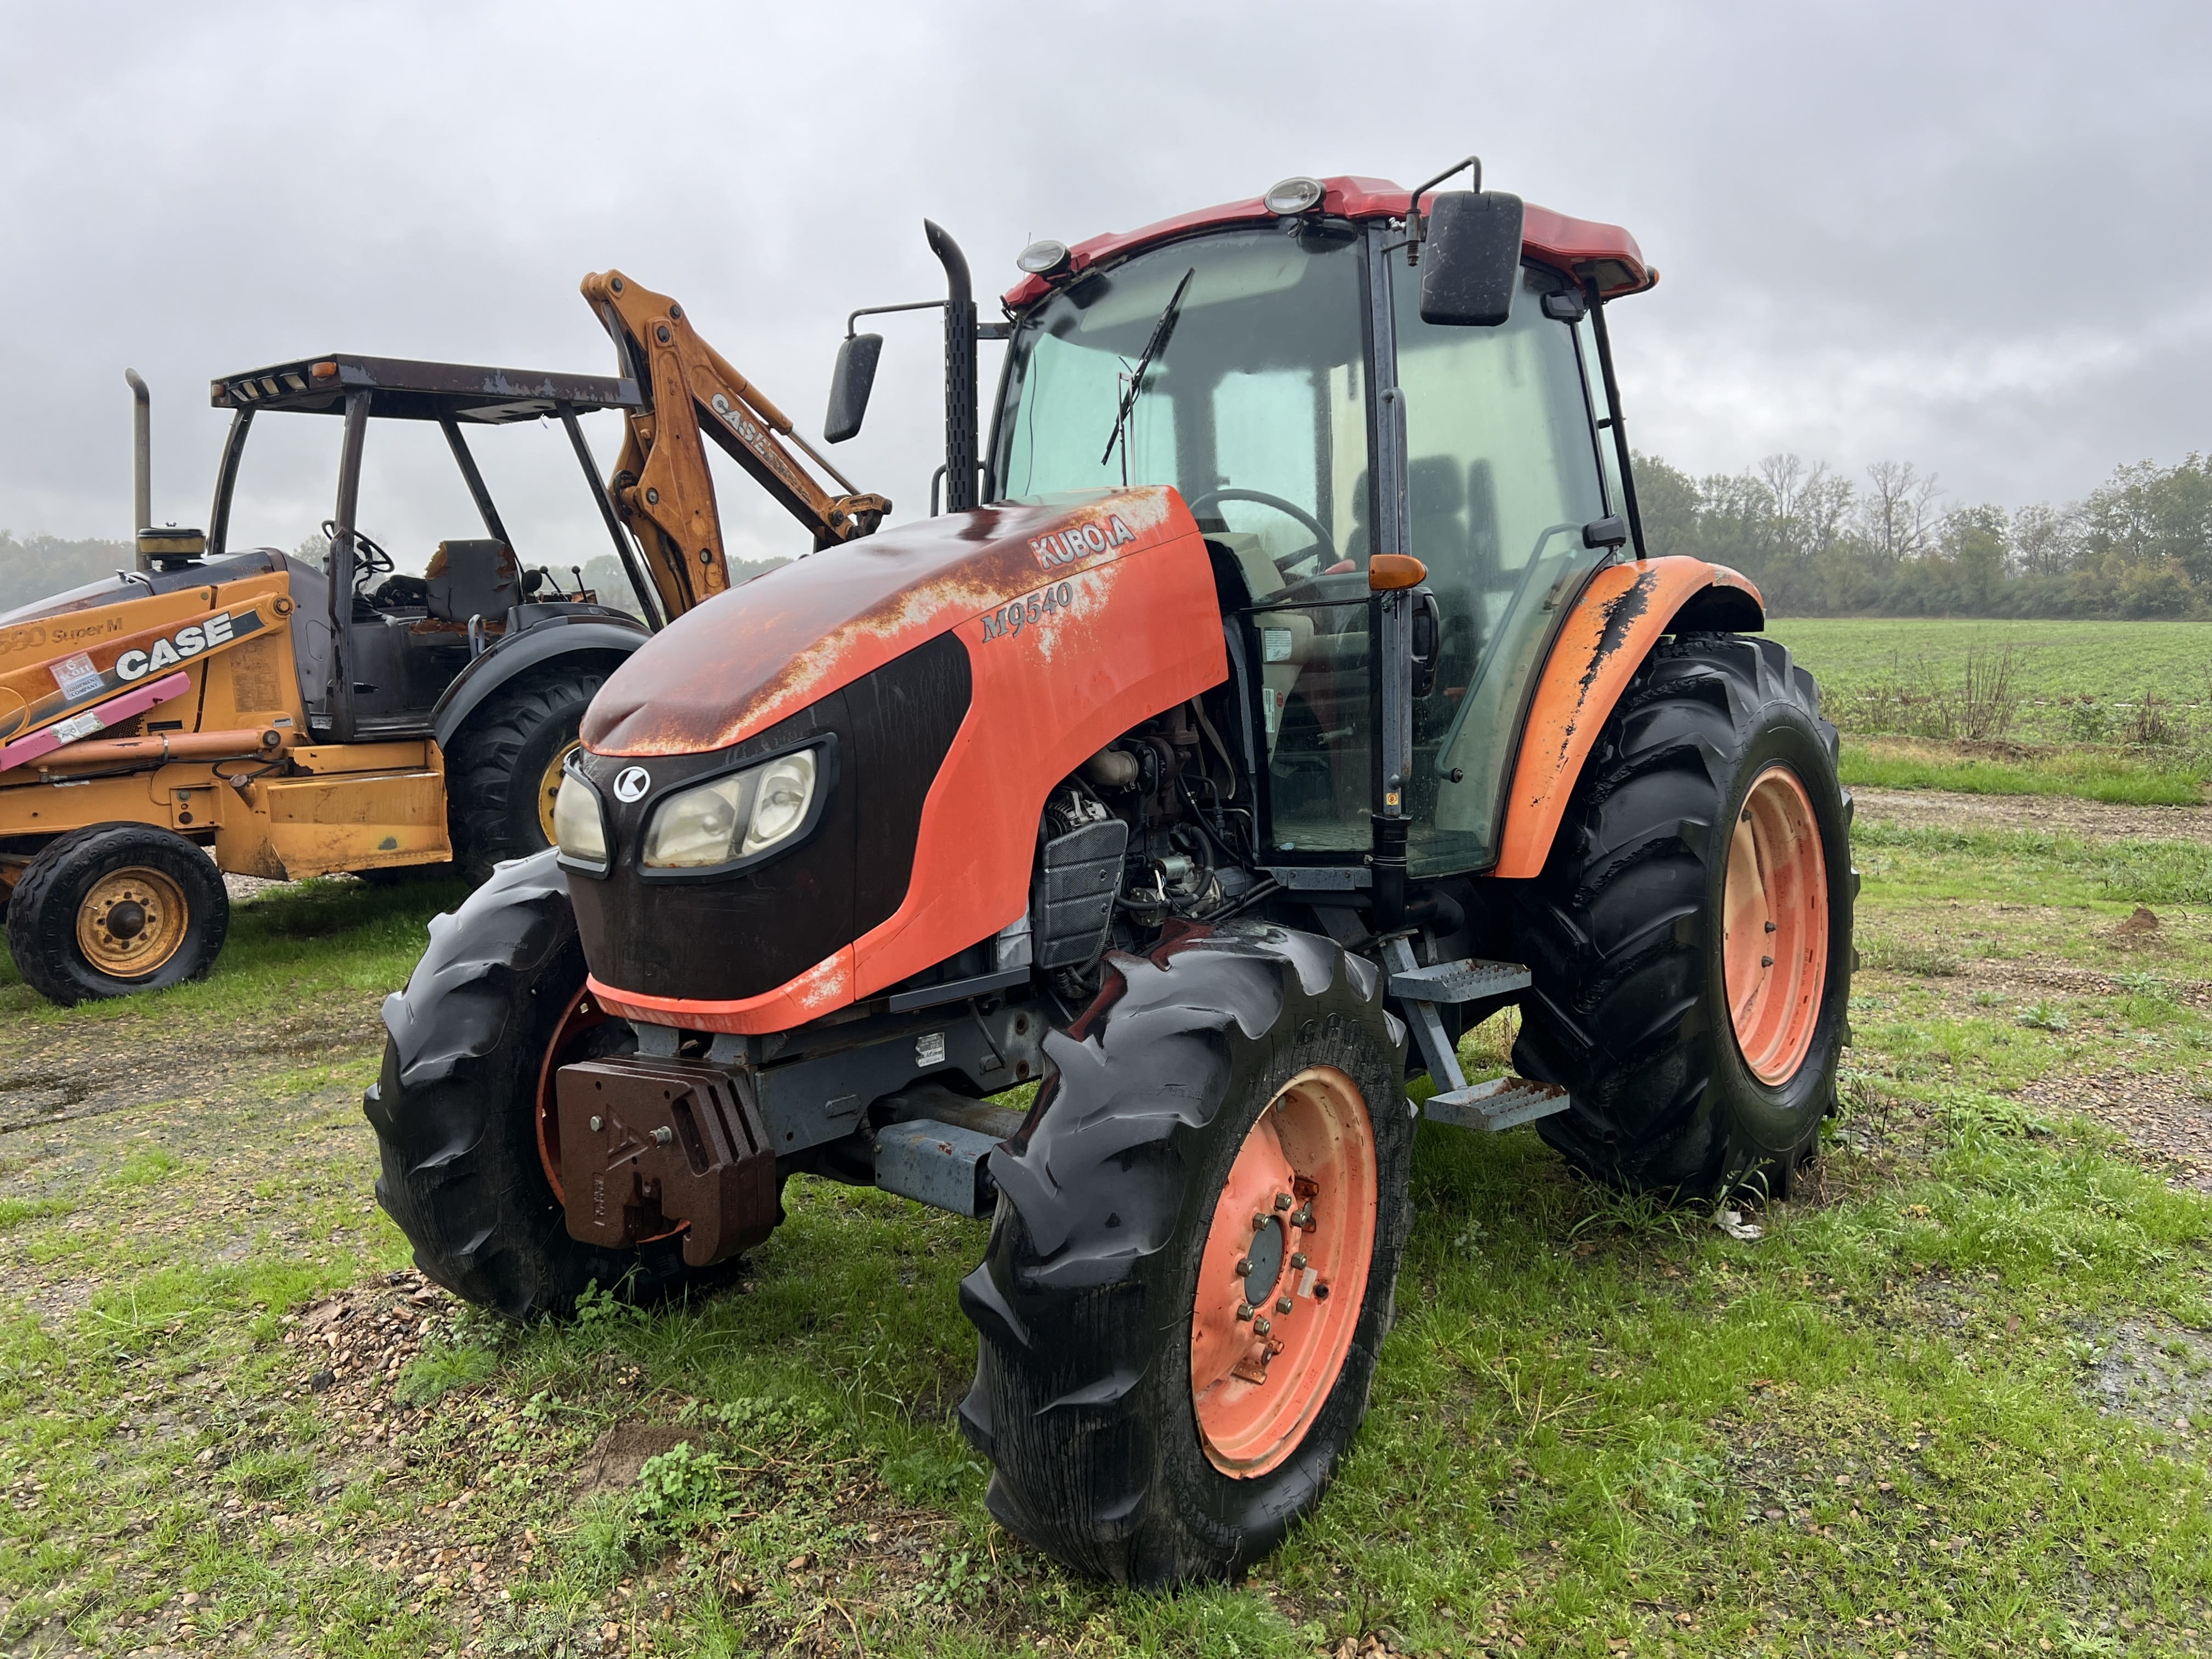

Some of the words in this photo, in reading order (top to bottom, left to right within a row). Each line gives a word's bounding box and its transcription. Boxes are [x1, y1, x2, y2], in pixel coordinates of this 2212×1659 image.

[711, 393, 772, 455] CASE
[52, 624, 104, 645] Super
[106, 617, 123, 633] M
[980, 582, 1073, 644] M9540
[116, 611, 234, 681] CASE
[66, 676, 97, 692] EQUIPMENT
[70, 683, 98, 698] COMPANY
